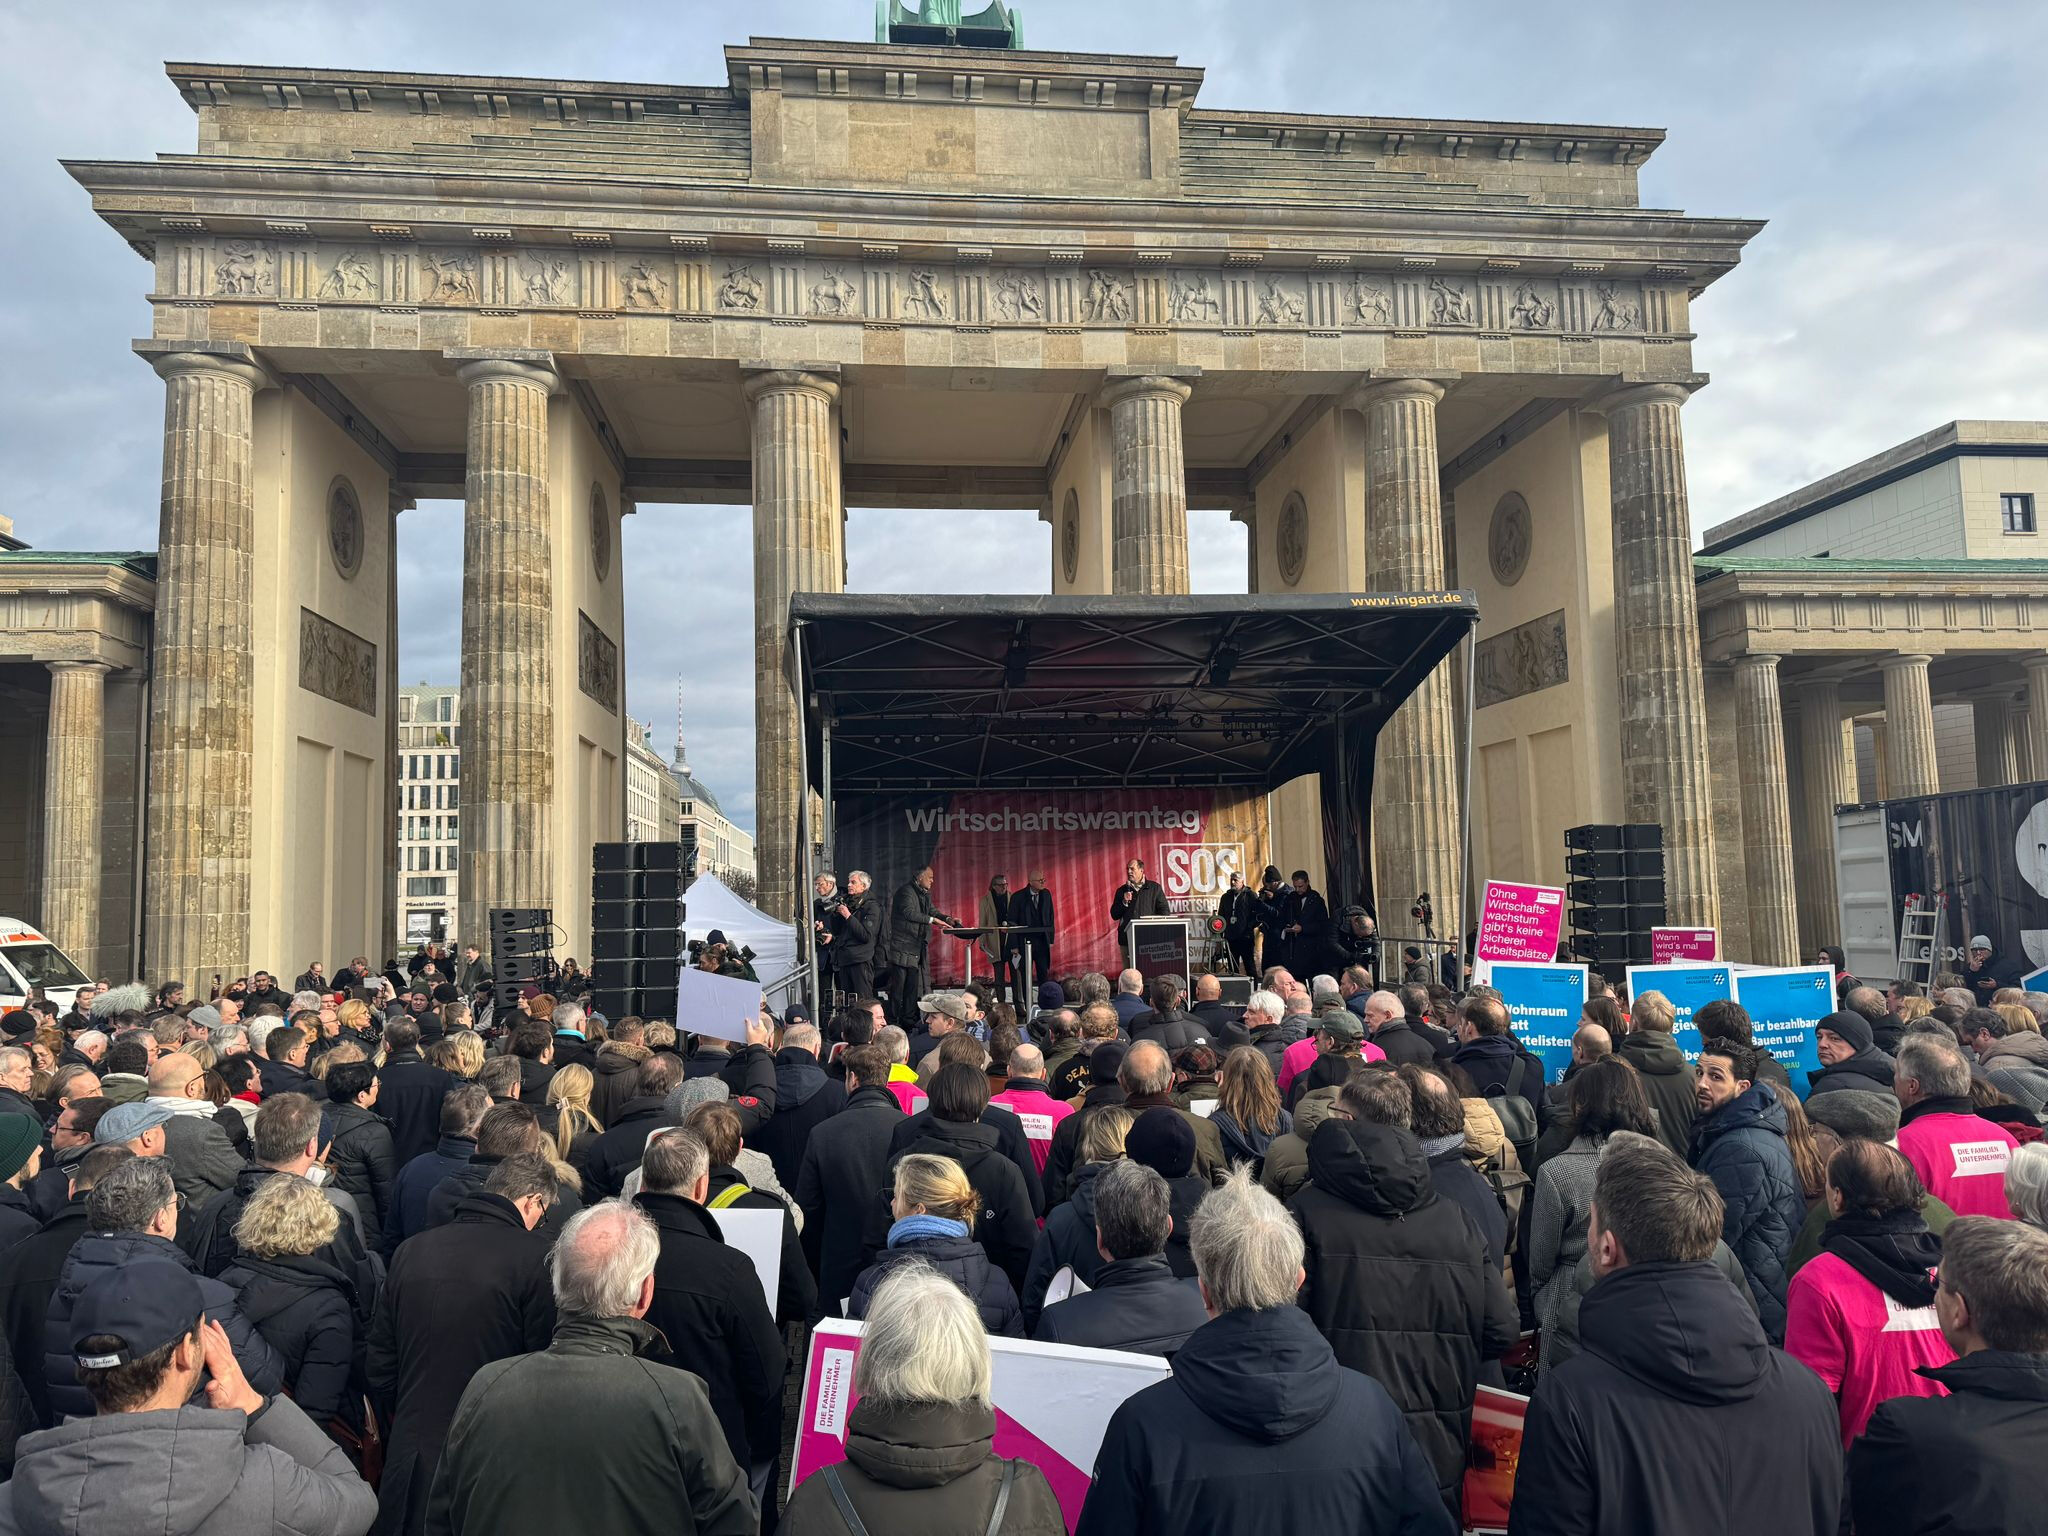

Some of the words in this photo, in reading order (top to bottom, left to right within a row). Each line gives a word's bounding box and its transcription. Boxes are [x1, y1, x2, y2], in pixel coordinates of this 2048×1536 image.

[1351, 593, 1462, 607] www.ingart.de
[905, 805, 1201, 835] Wirtschaftswarntag
[1166, 848, 1239, 894] SOS
[1489, 887, 1518, 900] Ohne
[1167, 898, 1221, 914] WIRTSCH
[1488, 899, 1550, 915] Wirtschafts-
[1486, 911, 1539, 925] wachstum
[1516, 925, 1544, 937] keine
[1655, 933, 1680, 941] Wann
[1482, 933, 1527, 946] sicheren
[1682, 942, 1699, 950] mal
[1481, 944, 1551, 961] Arbeitsplätze.
[1655, 950, 1685, 958] wieder
[1517, 1034, 1572, 1048] rtelisten
[1785, 1031, 1804, 1043] und
[1065, 1064, 1090, 1084] DEA
[1957, 1148, 1970, 1156] DIE
[1970, 1146, 1999, 1154] FAMILIEN
[1959, 1153, 2007, 1164] UNTERNEHMER
[822, 1367, 833, 1409] FAMILIEN
[826, 1358, 842, 1427] UNTERNEHMER
